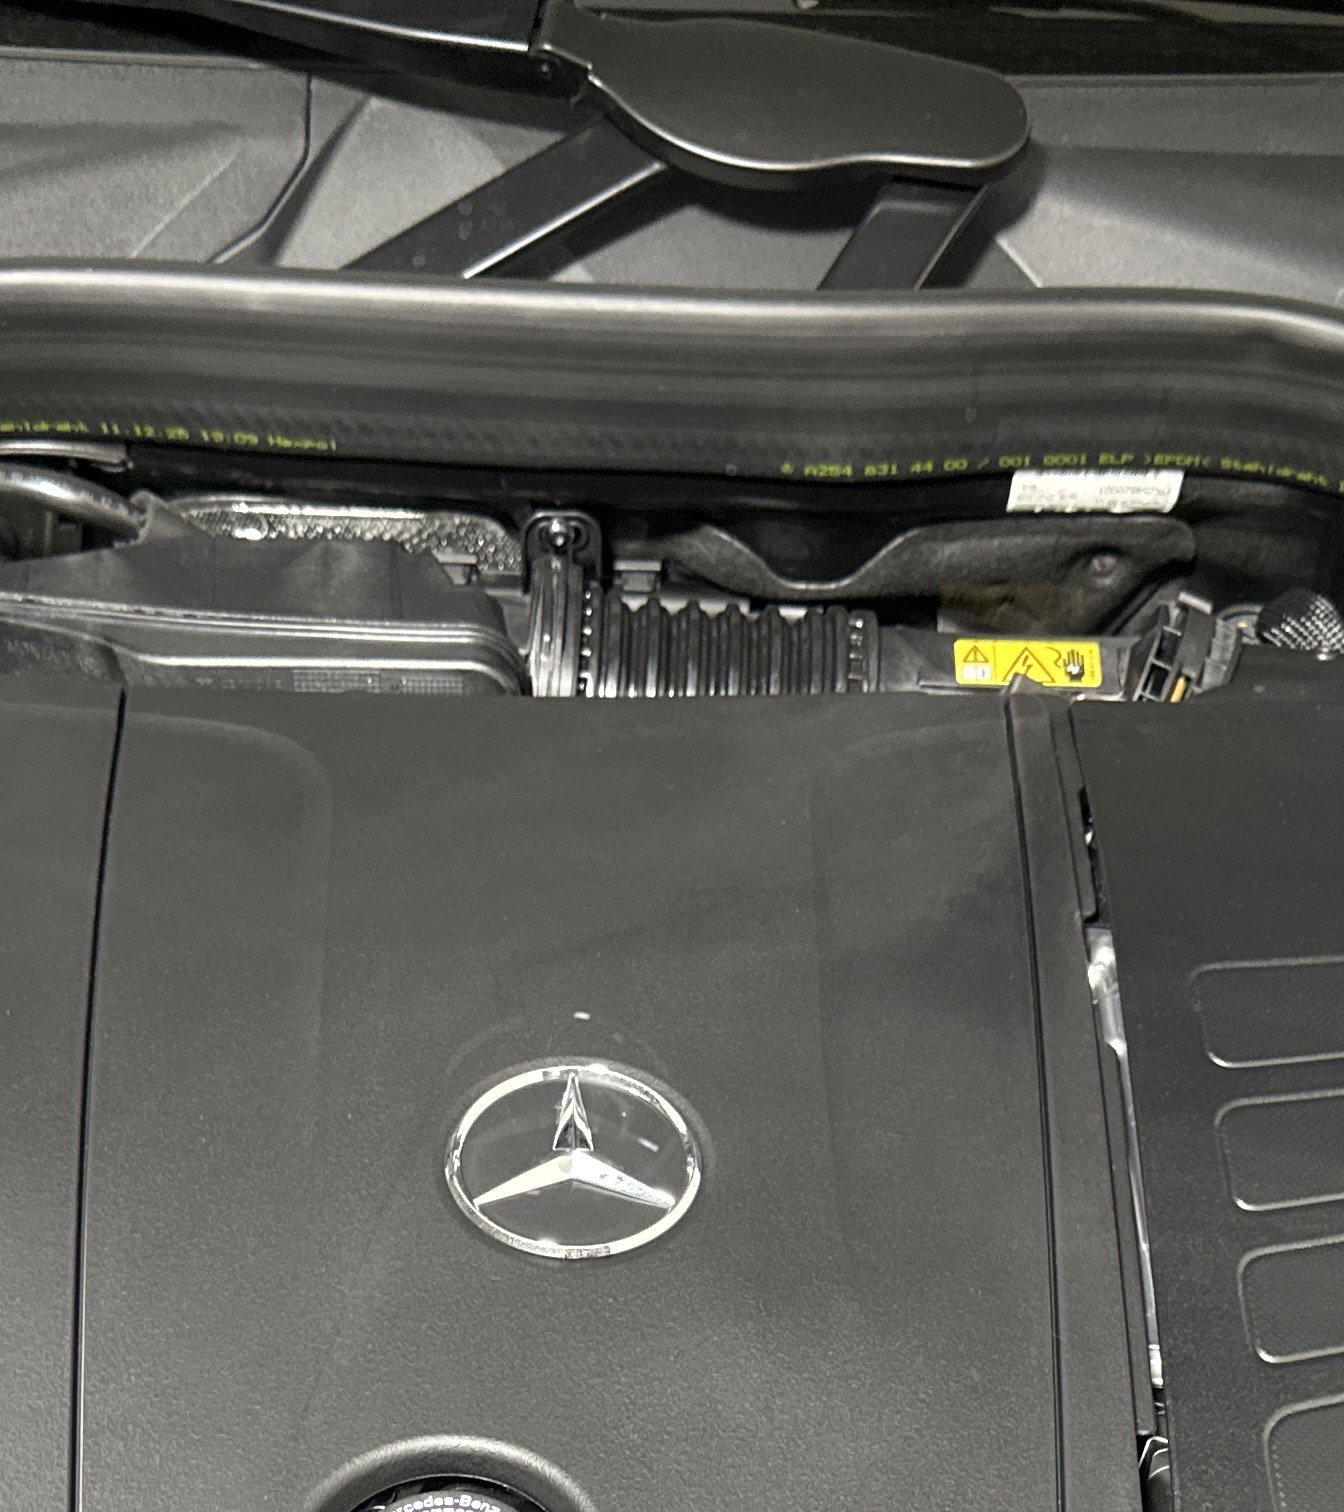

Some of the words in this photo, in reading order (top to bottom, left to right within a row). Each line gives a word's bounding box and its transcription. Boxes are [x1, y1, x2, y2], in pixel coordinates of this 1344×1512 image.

[943, 456, 969, 472] 00
[998, 454, 1031, 468] 001
[1042, 452, 1088, 468] 0001
